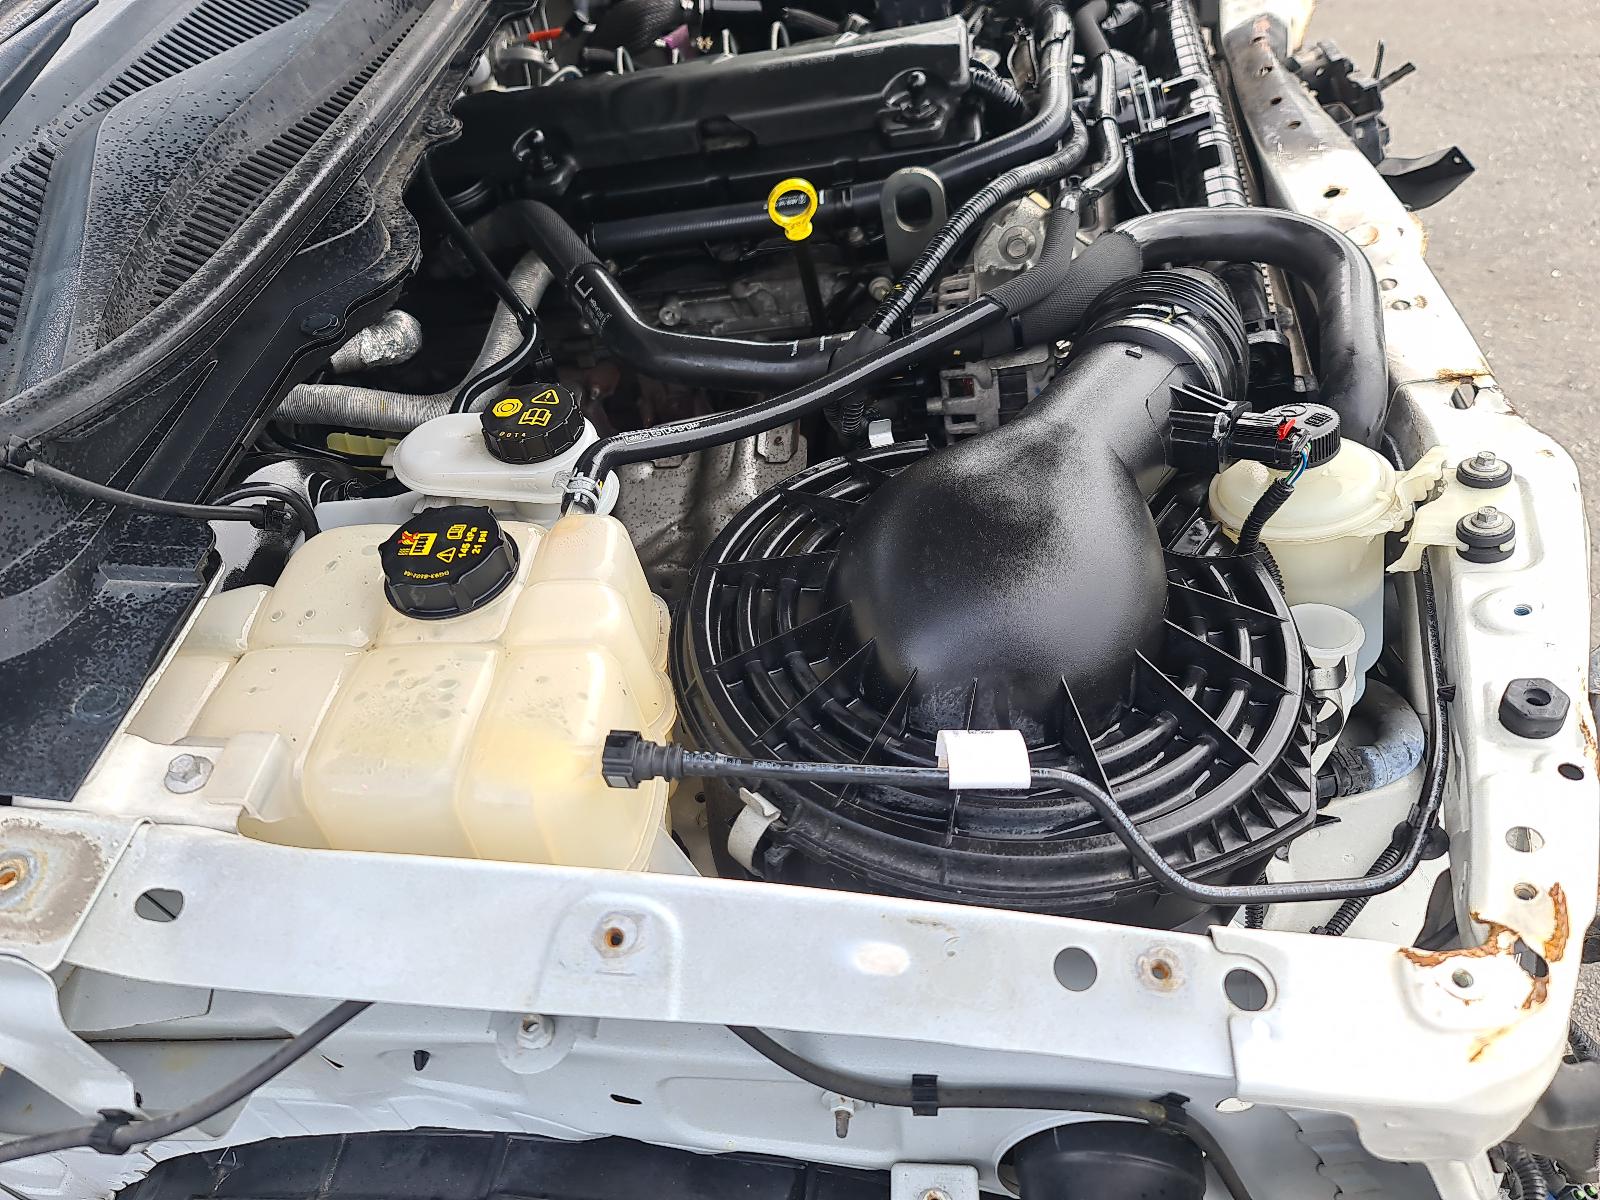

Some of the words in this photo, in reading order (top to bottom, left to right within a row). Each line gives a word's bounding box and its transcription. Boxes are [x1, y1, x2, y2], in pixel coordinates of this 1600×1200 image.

[458, 543, 471, 558] 145
[465, 527, 478, 542] kPa
[471, 544, 482, 554] 21
[478, 530, 488, 543] psi
